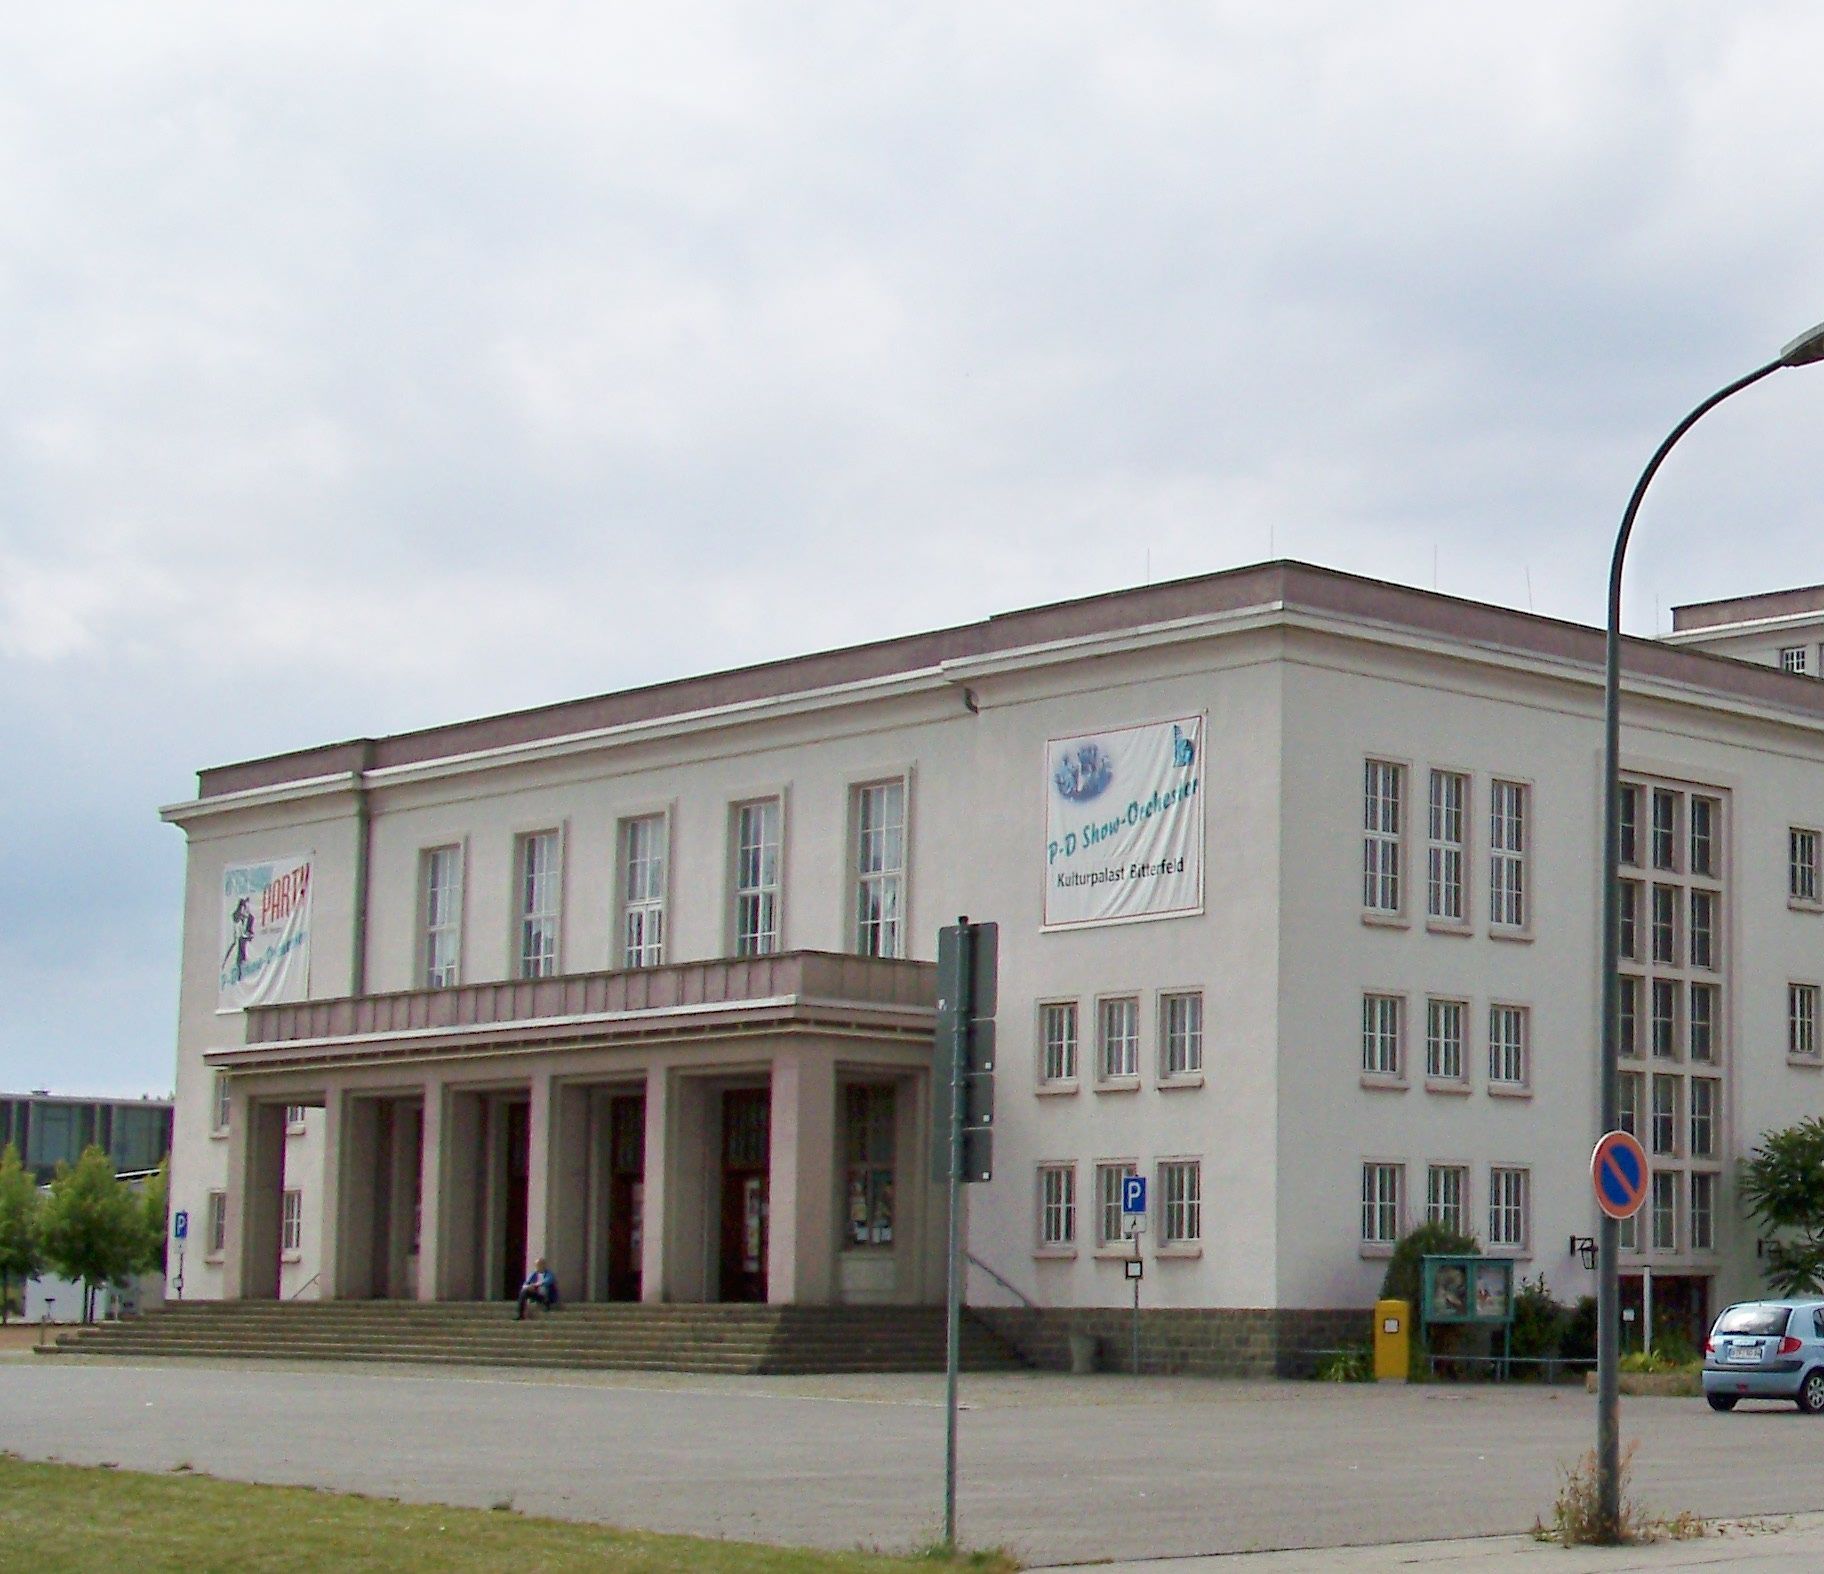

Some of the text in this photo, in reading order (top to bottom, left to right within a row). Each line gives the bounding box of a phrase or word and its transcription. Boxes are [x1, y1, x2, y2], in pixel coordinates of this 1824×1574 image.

[1049, 778, 1198, 865] P-D Show-Orchester
[1057, 857, 1184, 888] Kulturpalast Bitterfeld
[1128, 1181, 1142, 1209] P
[177, 1215, 186, 1236] P
